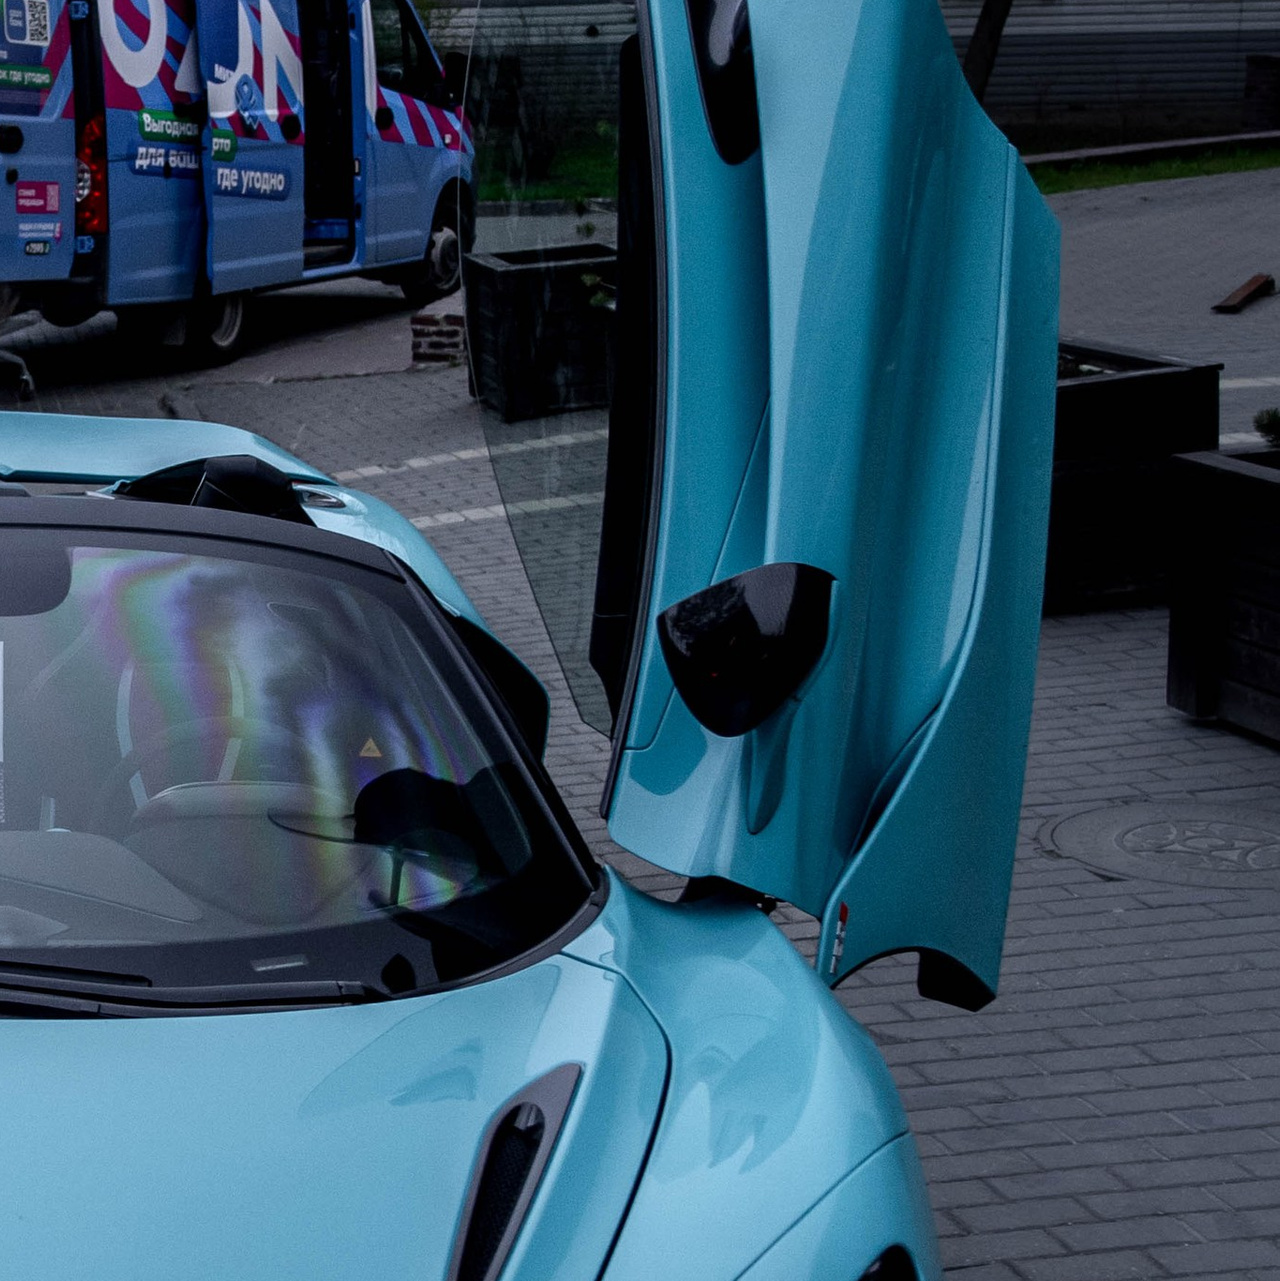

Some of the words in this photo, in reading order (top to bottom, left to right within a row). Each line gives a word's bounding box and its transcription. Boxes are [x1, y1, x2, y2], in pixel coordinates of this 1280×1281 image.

[142, 112, 199, 137] Выгодная
[212, 137, 232, 157] рта
[135, 146, 166, 170] для
[168, 150, 200, 169] ваш
[217, 167, 238, 191] где
[241, 170, 286, 195] угодно
